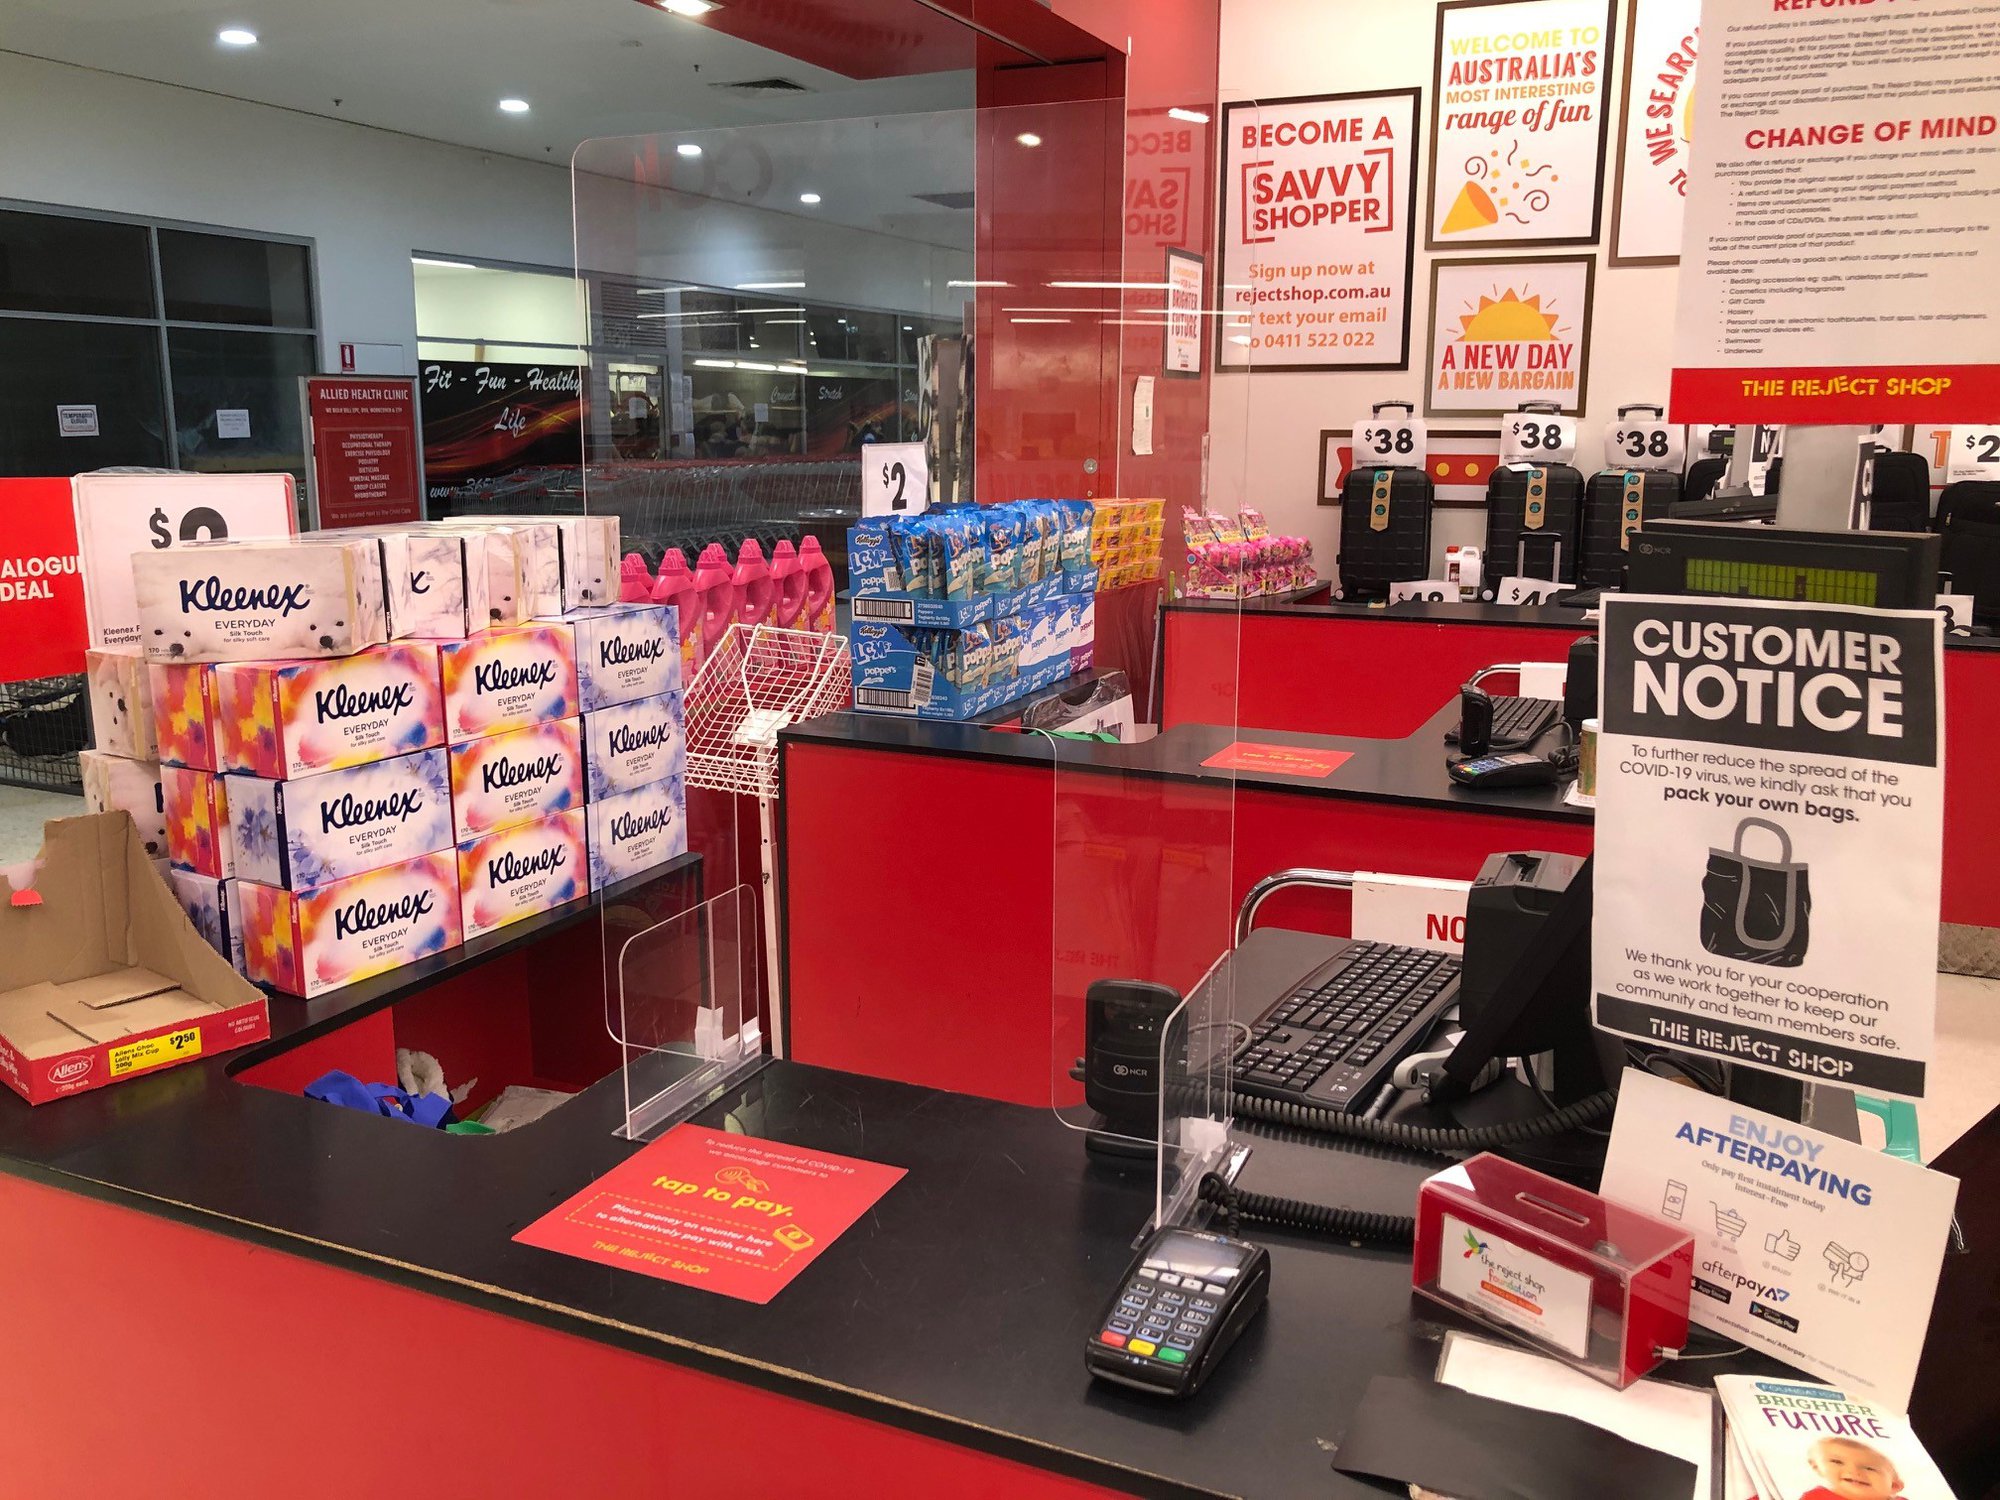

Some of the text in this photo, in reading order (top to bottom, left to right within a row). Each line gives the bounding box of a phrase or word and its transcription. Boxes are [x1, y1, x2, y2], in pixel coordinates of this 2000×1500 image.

[1449, 26, 1600, 55] WELCOME TO
[1448, 50, 1597, 86] AUSTRALIA'S
[1446, 81, 1596, 104] MOST INTERESTING
[1646, 27, 1699, 166] WE SEARC
[1242, 116, 1393, 148] BECOME A
[1445, 99, 1593, 134] range of fun
[1744, 115, 1998, 149] CHANGE OF MIND
[1253, 161, 1381, 204] SAVVY
[1253, 198, 1381, 231] SHOPPER
[1249, 260, 1375, 281] Sign up now at
[1236, 286, 1391, 305] rejectshop.com.au
[1260, 307, 1387, 328] text your email
[1265, 331, 1375, 348] 0411 522 022
[1441, 344, 1573, 370] A NEW DAY
[320, 388, 409, 400] ALLIED HEALTH CLINIC
[425, 365, 583, 396] Fit Fun Healthy
[1438, 371, 1574, 390] A NEW BARGAIN
[1741, 375, 1952, 396] THE REJECT SHOP
[494, 407, 526, 438] Life
[1512, 422, 1562, 450] $38
[1365, 428, 1414, 454] $38
[1616, 430, 1669, 457] $38
[882, 462, 907, 511] $2
[0, 580, 54, 602] DEAL
[179, 576, 311, 617] Kleenex
[215, 619, 277, 629] EVERYDAY
[600, 635, 664, 668] Kleenex
[1633, 618, 1903, 676] CUSTOMER
[475, 659, 557, 695] Kleenex
[315, 682, 413, 724] Kleenex
[497, 692, 536, 707] EVERYDAY
[1633, 659, 1903, 738] NOTICE
[343, 718, 390, 736] EVERYDAY
[609, 722, 670, 758] Kleenex
[482, 753, 562, 793] Kleenex
[1632, 744, 1899, 786] To further reduce the spread of the
[504, 786, 543, 803] EVERYDAY
[1619, 760, 1912, 809] COVID-19 virus, we kindly ask that you
[321, 788, 422, 834] Kleenex
[1663, 785, 1860, 824] pack your own bags.
[349, 825, 397, 844] EVERYDAY
[611, 806, 671, 846] Kleenex
[489, 844, 566, 889] Kleenex
[510, 878, 547, 897] EVERYDAY
[335, 890, 433, 940] Kleenex
[362, 927, 409, 949] EVERYDAY
[1625, 948, 1889, 1012] We thank you for your cooperation
[1633, 968, 1879, 1027] as we work together to keep our
[1616, 982, 1901, 1051] community and team members safe.
[115, 1048, 160, 1063] Lolly Mix Cup
[1650, 1017, 1854, 1077] THE REJECT SHOP
[52, 1059, 90, 1078] Allen's
[1129, 1068, 1148, 1076] NCR
[1728, 1114, 1825, 1162] ENJOY
[1675, 1121, 1873, 1206] AFTERPAYING
[651, 1175, 793, 1217] tap to pay.
[1701, 1159, 1826, 1212] Only pay first instalment today
[595, 1212, 608, 1220] to
[609, 1214, 680, 1238] alternatively
[681, 1232, 707, 1245] pay
[708, 1237, 734, 1250] with
[612, 1203, 774, 1248] Place money on counter here
[1701, 1260, 1766, 1297] afterpay
[1755, 1394, 1875, 1417] BRIGHTER
[1762, 1407, 1890, 1439] FUTURE
